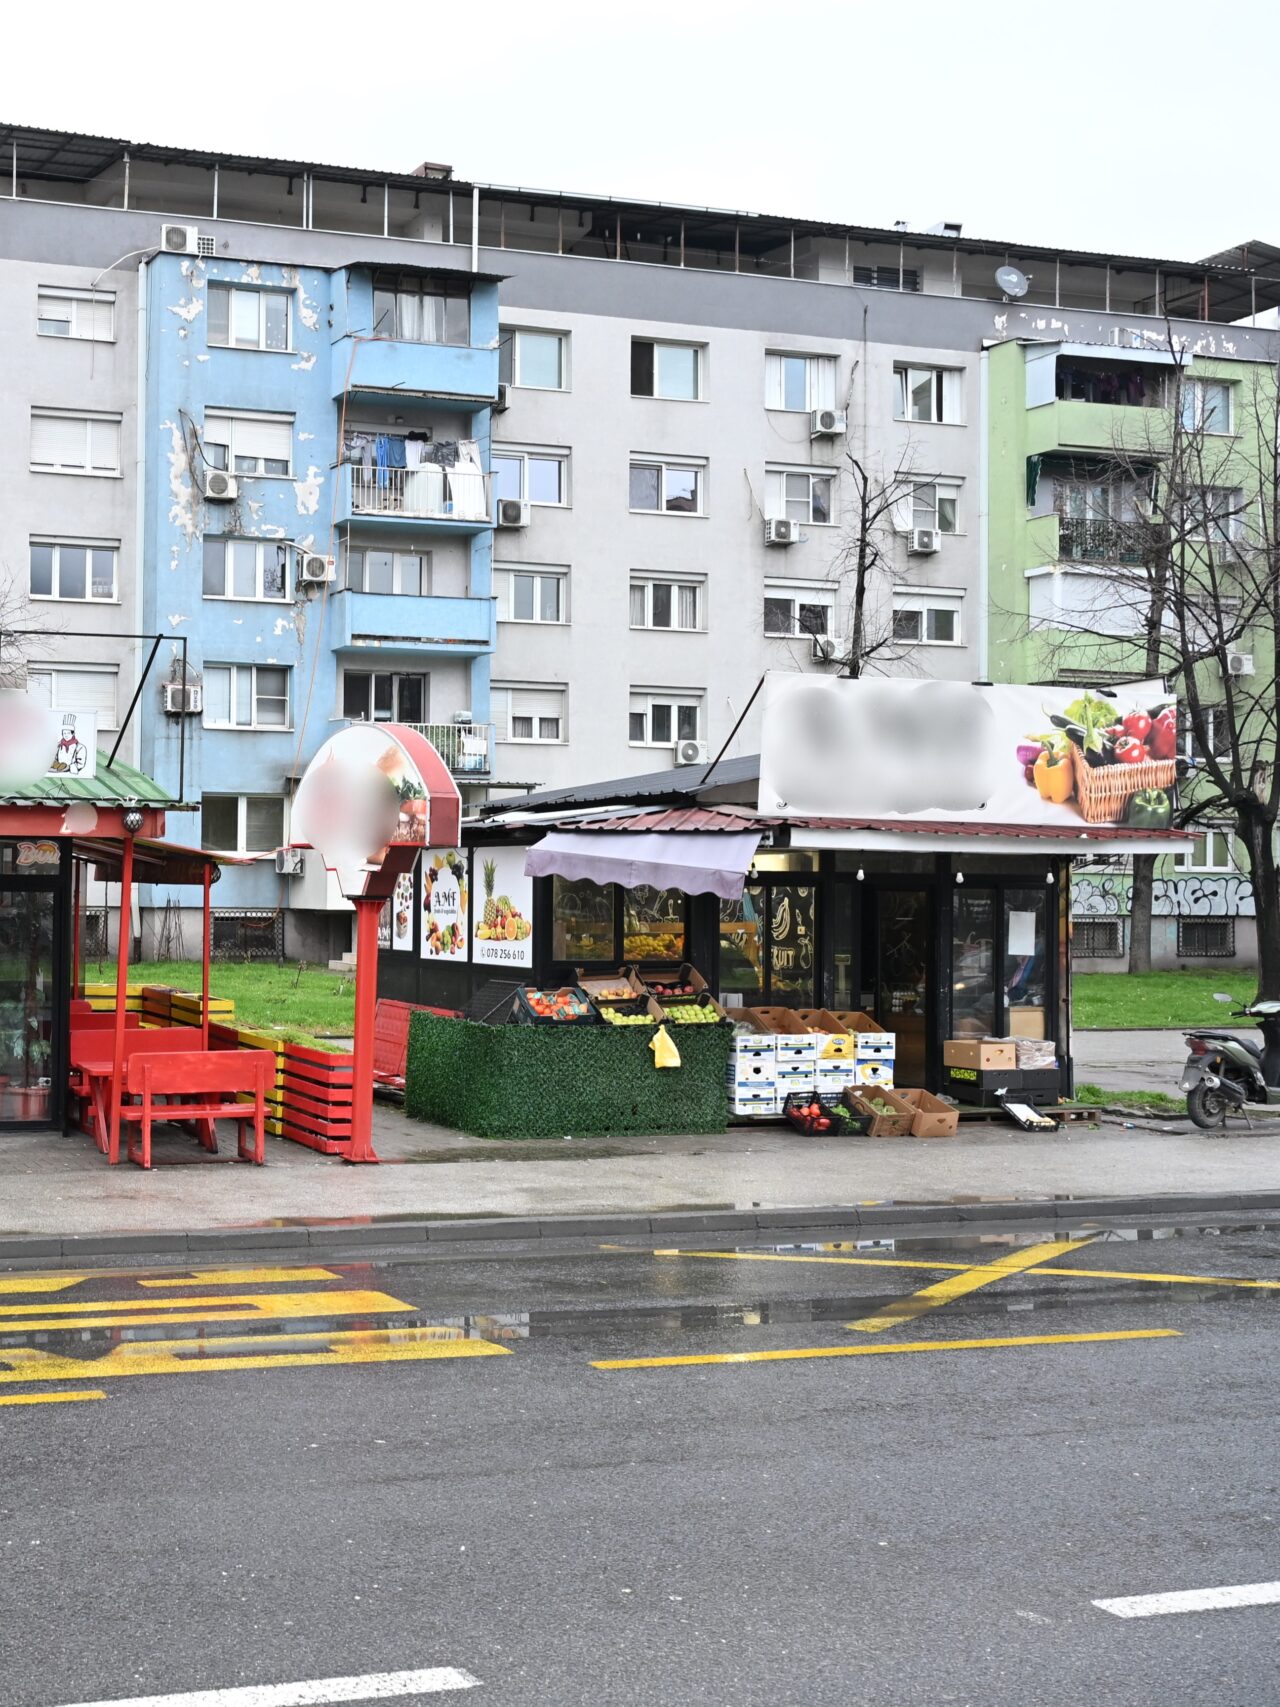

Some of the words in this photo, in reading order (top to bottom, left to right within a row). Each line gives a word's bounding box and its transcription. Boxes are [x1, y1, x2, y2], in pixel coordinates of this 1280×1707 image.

[486, 948, 498, 958] 078
[499, 948, 511, 960] 256
[512, 949, 525, 961] 610
[771, 945, 795, 970] RUIT
